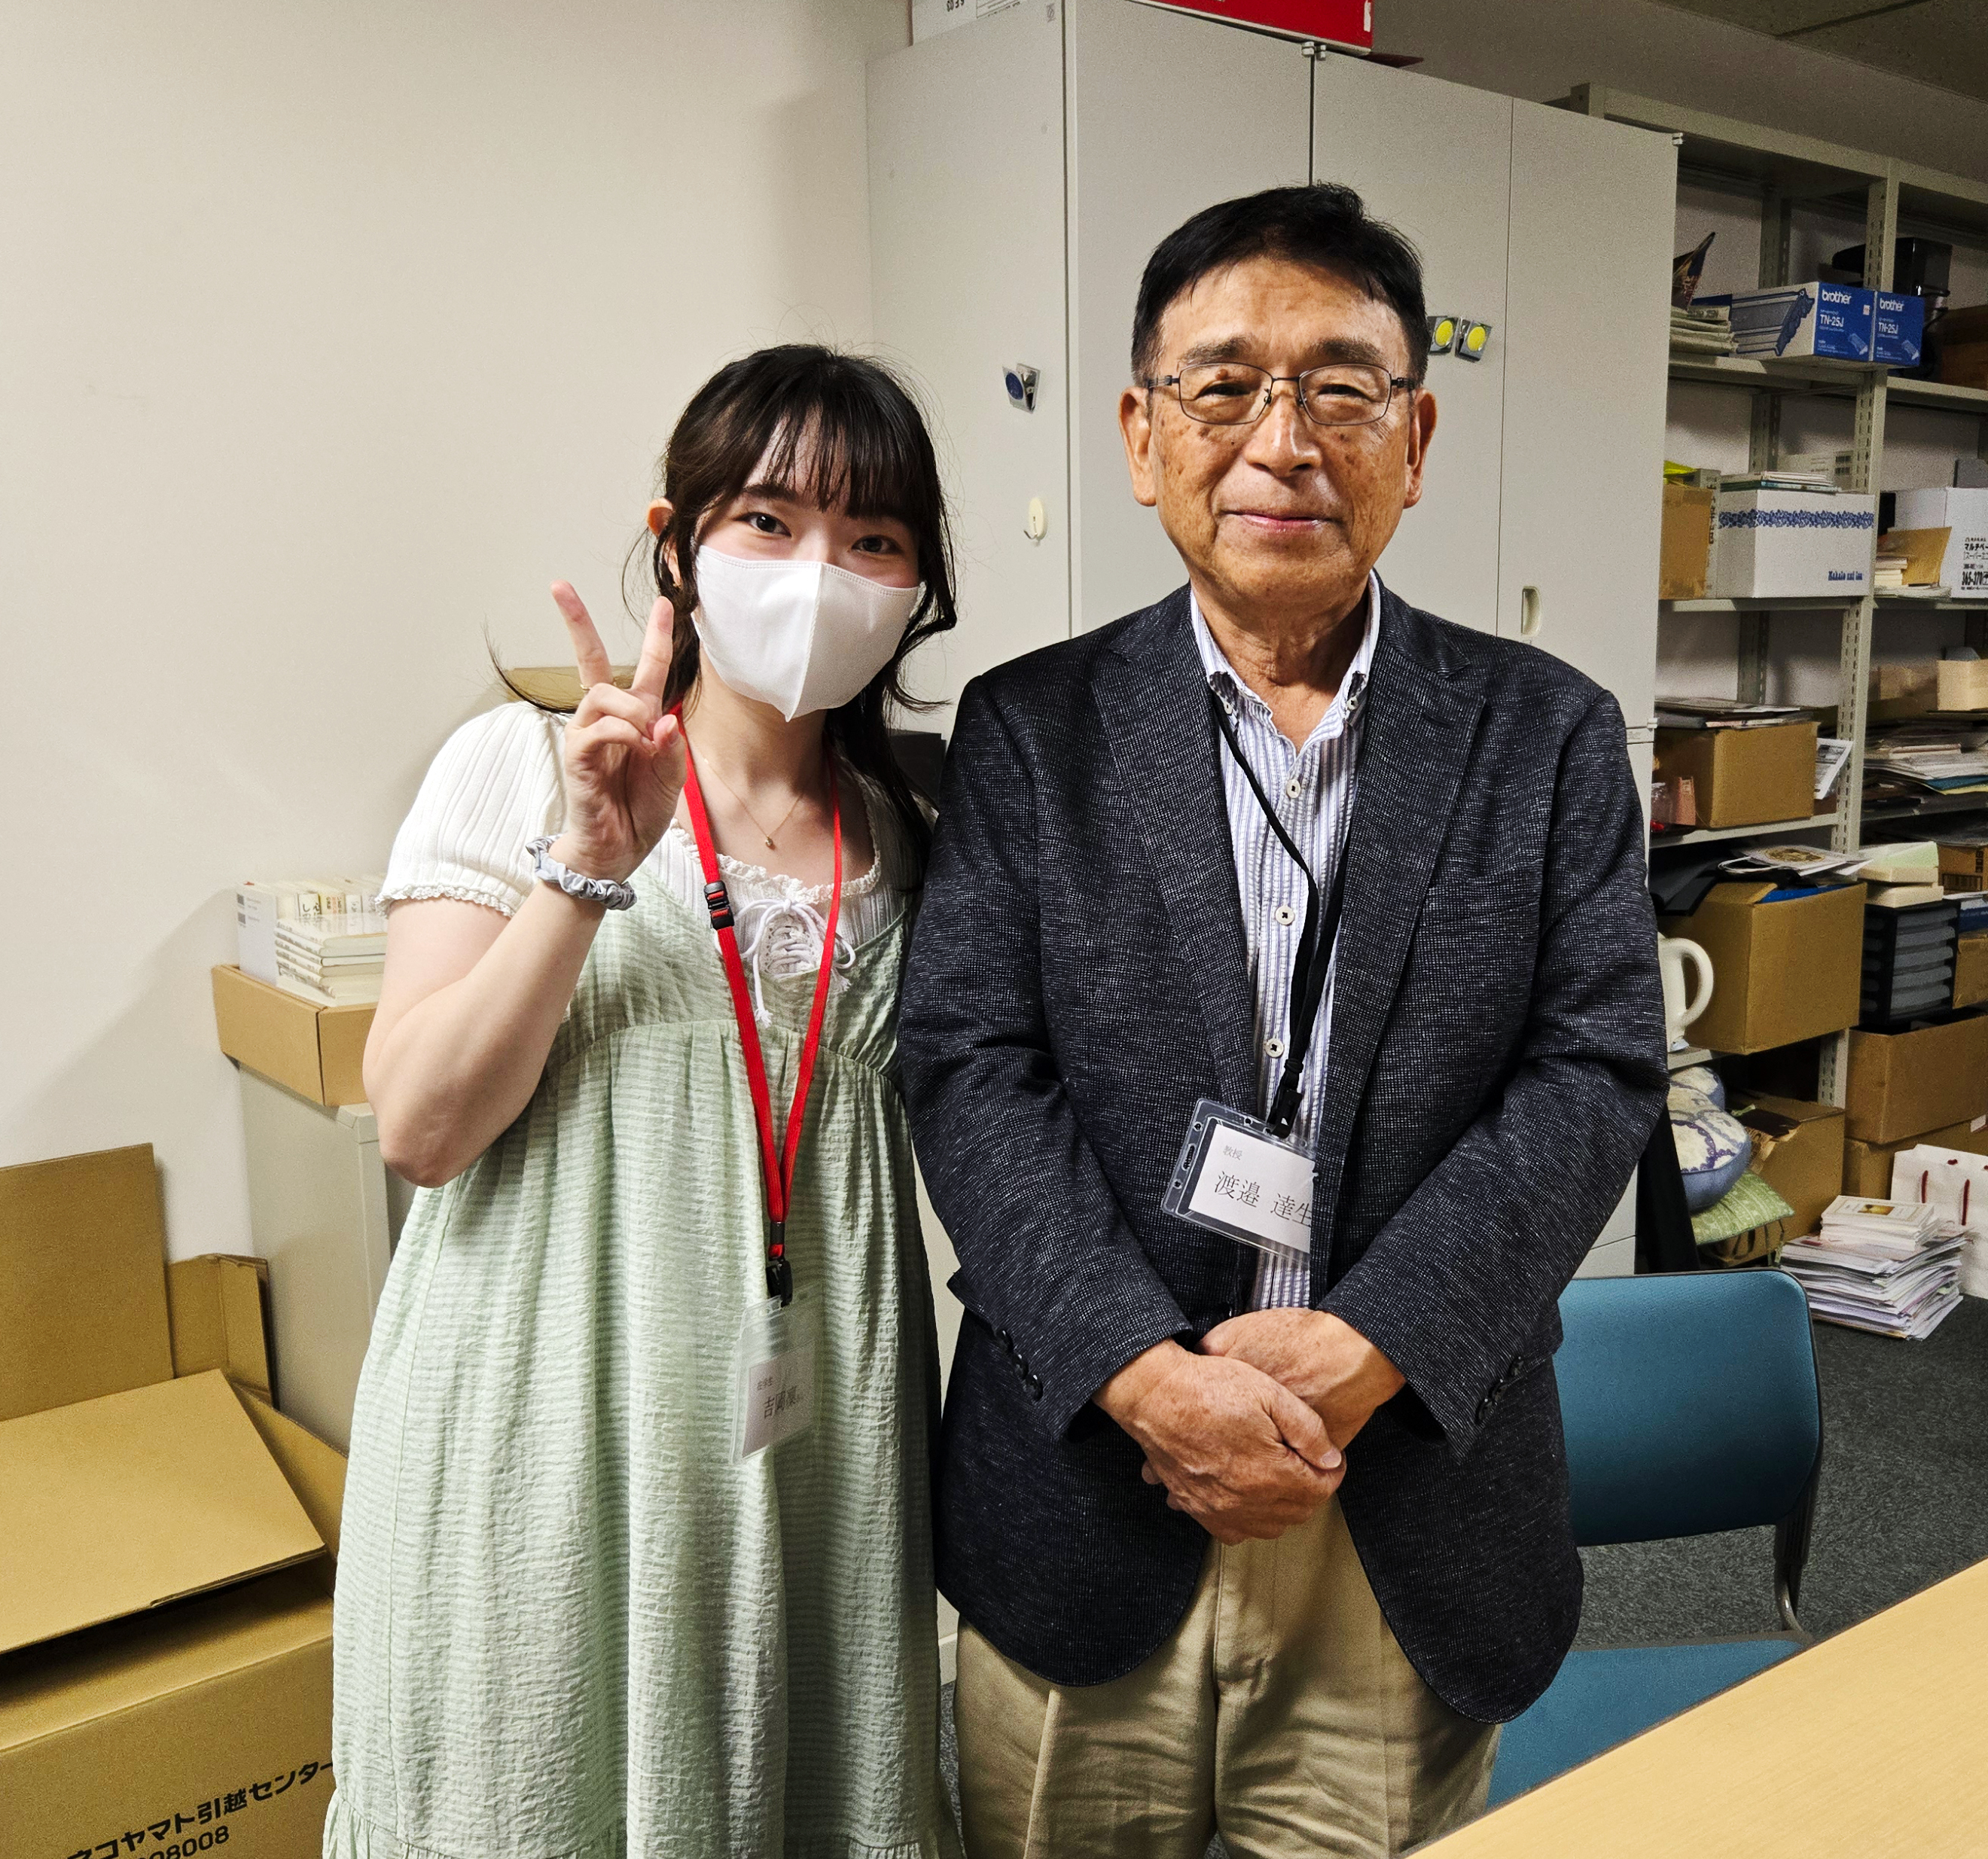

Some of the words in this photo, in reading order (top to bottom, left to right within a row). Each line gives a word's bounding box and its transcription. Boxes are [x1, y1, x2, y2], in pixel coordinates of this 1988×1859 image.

[1822, 289, 1852, 305] brother
[1880, 297, 1905, 312] brother
[1820, 314, 1845, 328] TN-25J
[1878, 322, 1899, 334] TN-25J
[1222, 1144, 1243, 1161] 教授
[1270, 1193, 1313, 1228] 達生
